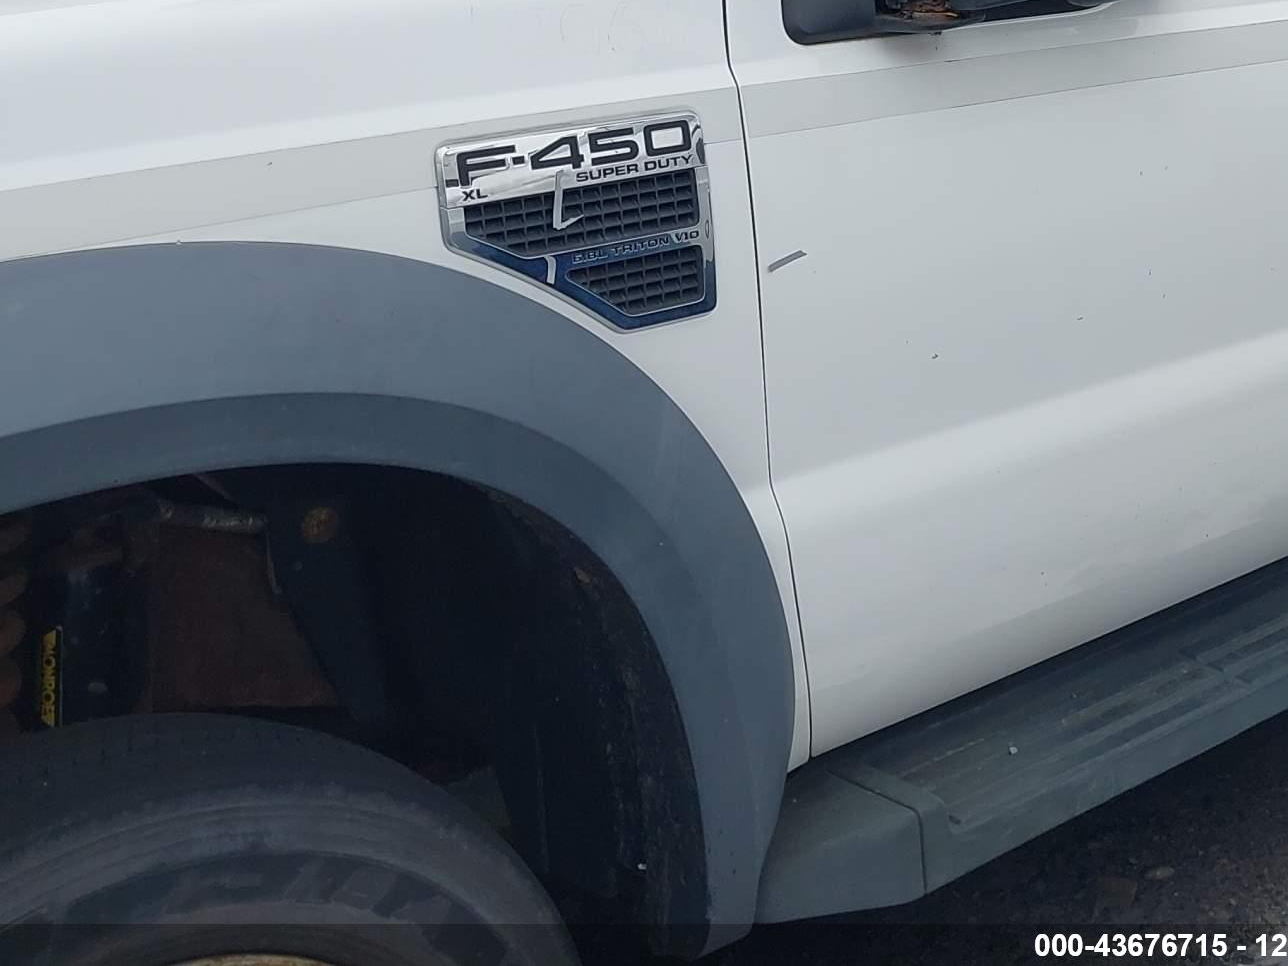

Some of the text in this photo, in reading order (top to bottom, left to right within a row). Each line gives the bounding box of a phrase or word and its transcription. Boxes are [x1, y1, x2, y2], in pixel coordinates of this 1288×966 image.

[457, 120, 692, 187] F-450
[576, 154, 693, 183] SUPER DUTY
[462, 188, 489, 202] XL
[611, 235, 670, 257] TRITON
[40, 643, 56, 716] MONROE
